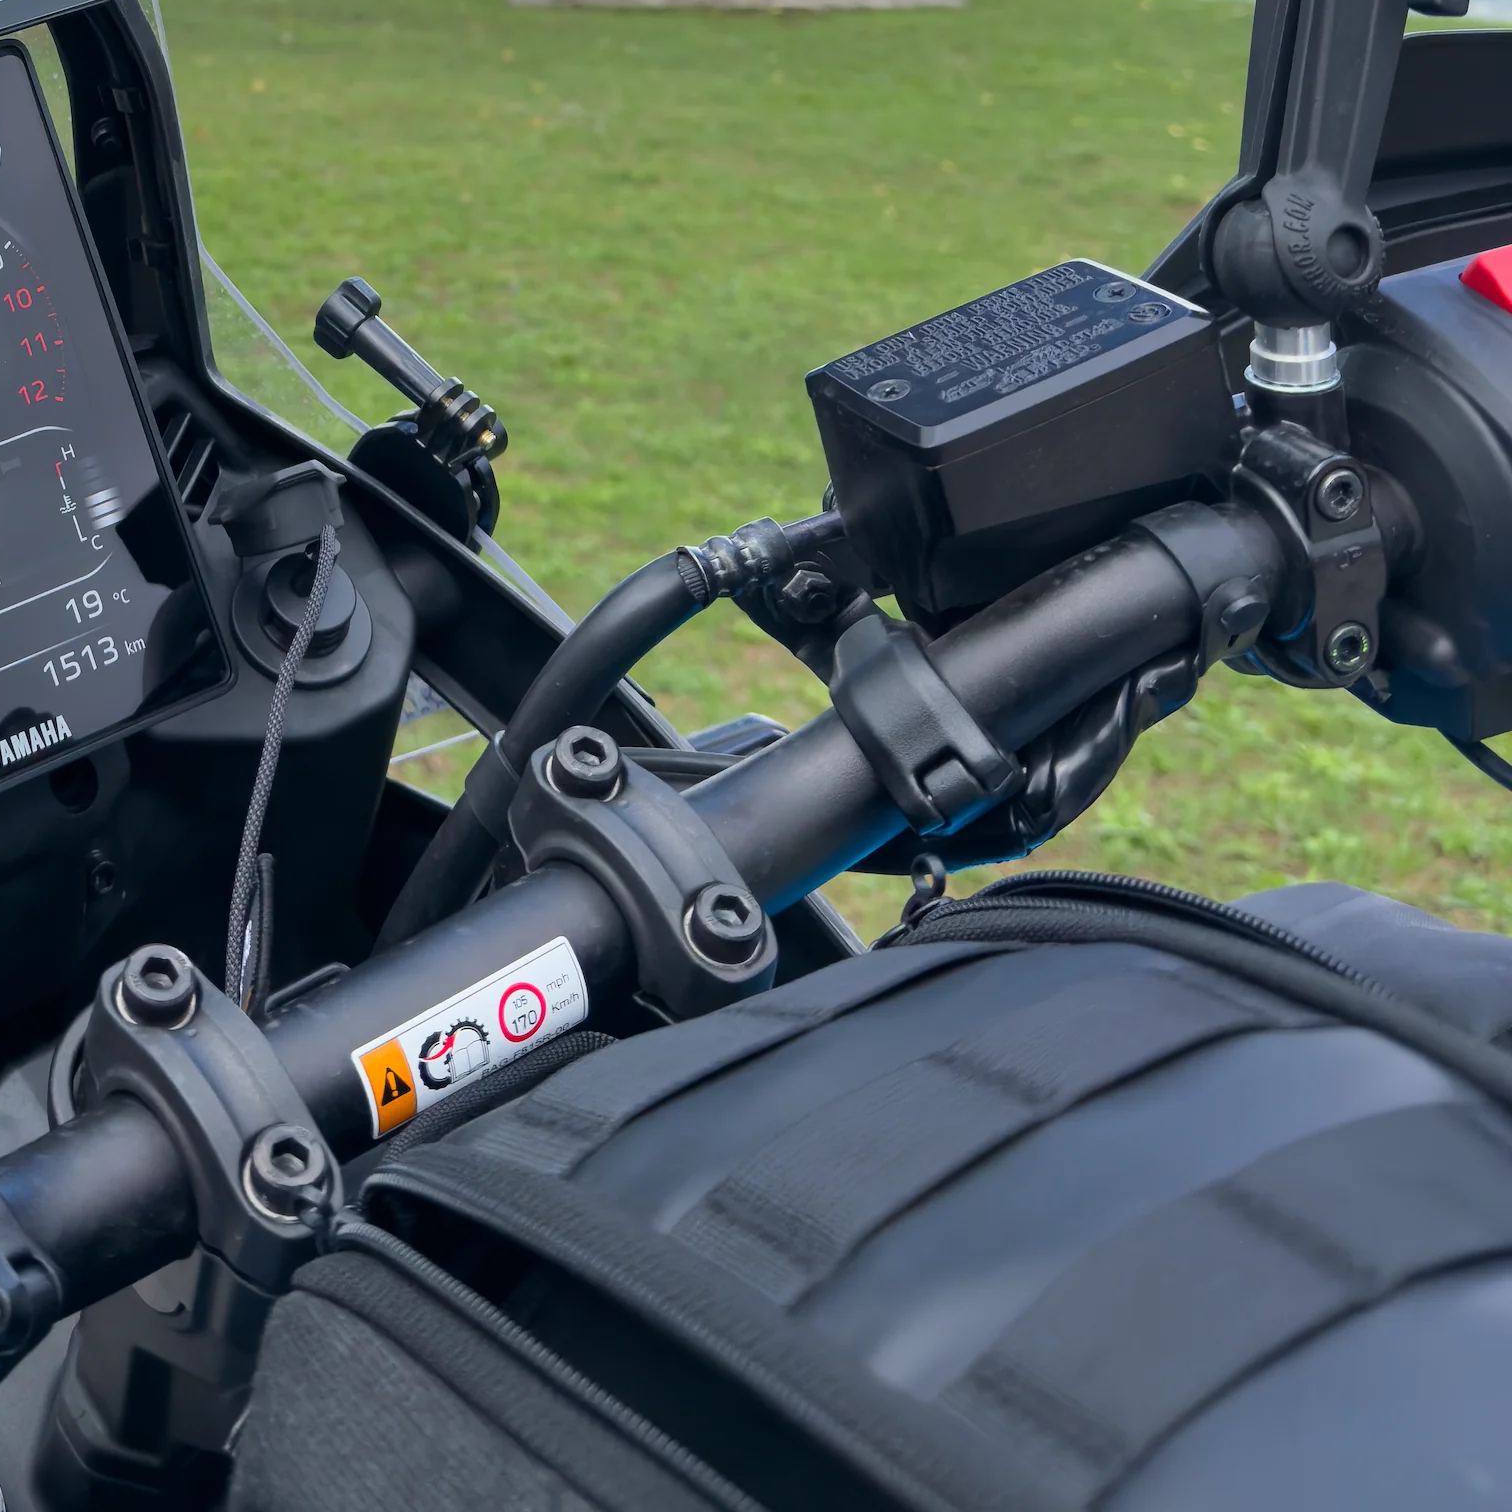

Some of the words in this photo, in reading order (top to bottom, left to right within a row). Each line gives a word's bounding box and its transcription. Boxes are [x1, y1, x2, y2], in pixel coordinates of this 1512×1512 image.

[3, 288, 33, 313] 10
[20, 332, 48, 357] 11
[18, 380, 49, 405] 12
[60, 443, 76, 462] H
[91, 534, 104, 551] C
[65, 589, 104, 624] 19
[43, 636, 119, 687] 1513
[124, 637, 148, 656] km
[545, 972, 570, 993] mph
[551, 991, 581, 1014] Km/h
[511, 1009, 539, 1034] 170
